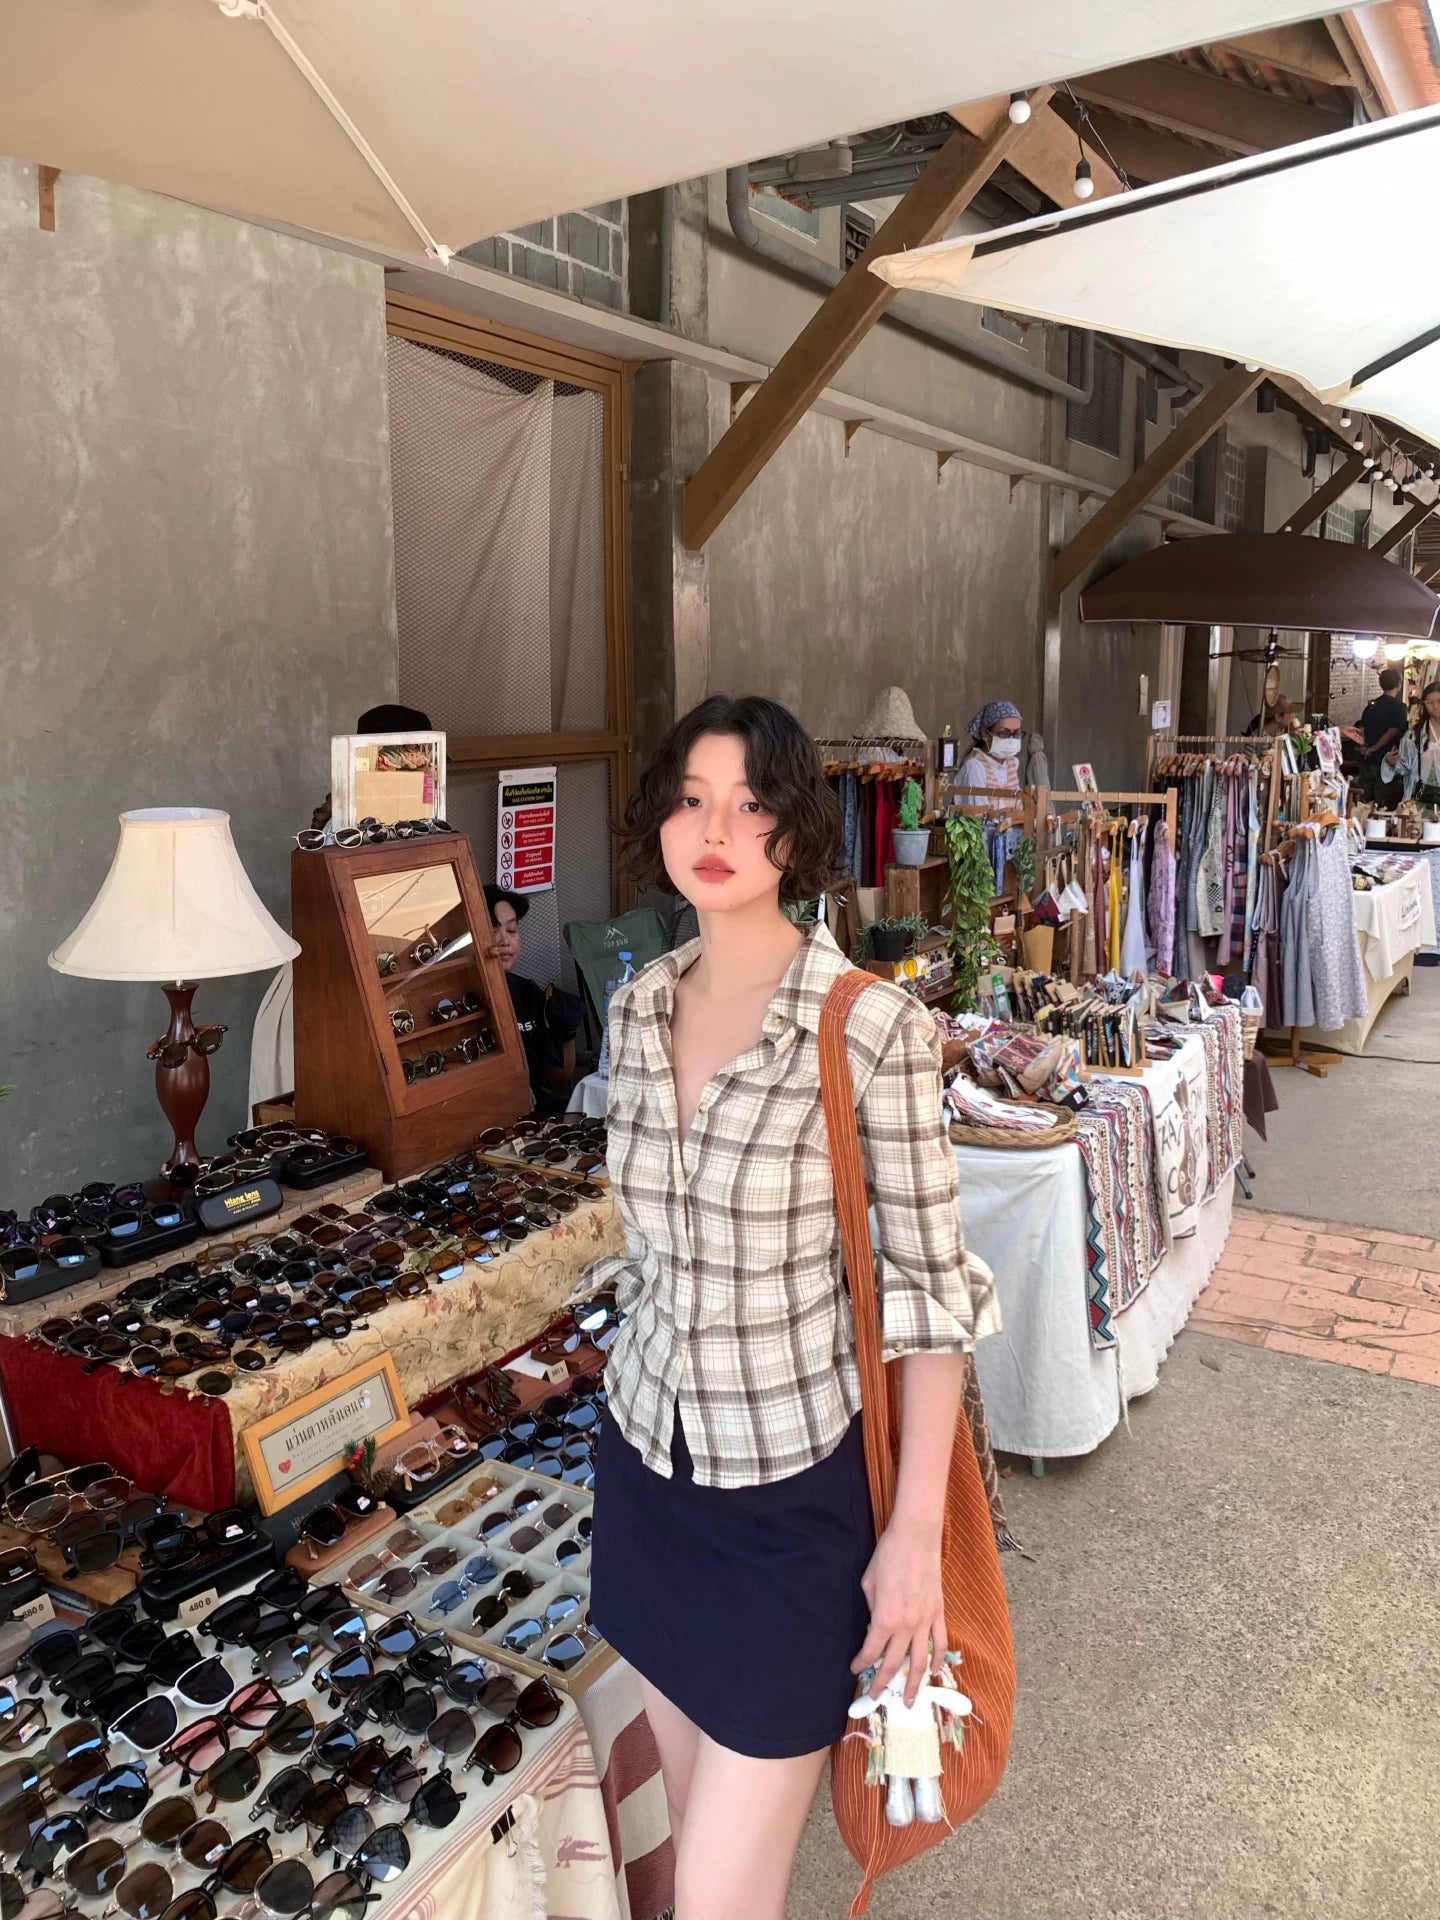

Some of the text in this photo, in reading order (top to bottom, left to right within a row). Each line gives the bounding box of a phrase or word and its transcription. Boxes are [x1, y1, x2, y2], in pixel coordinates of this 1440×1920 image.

[602, 938, 629, 949] TOP SUN
[188, 1600, 204, 1613] 480
